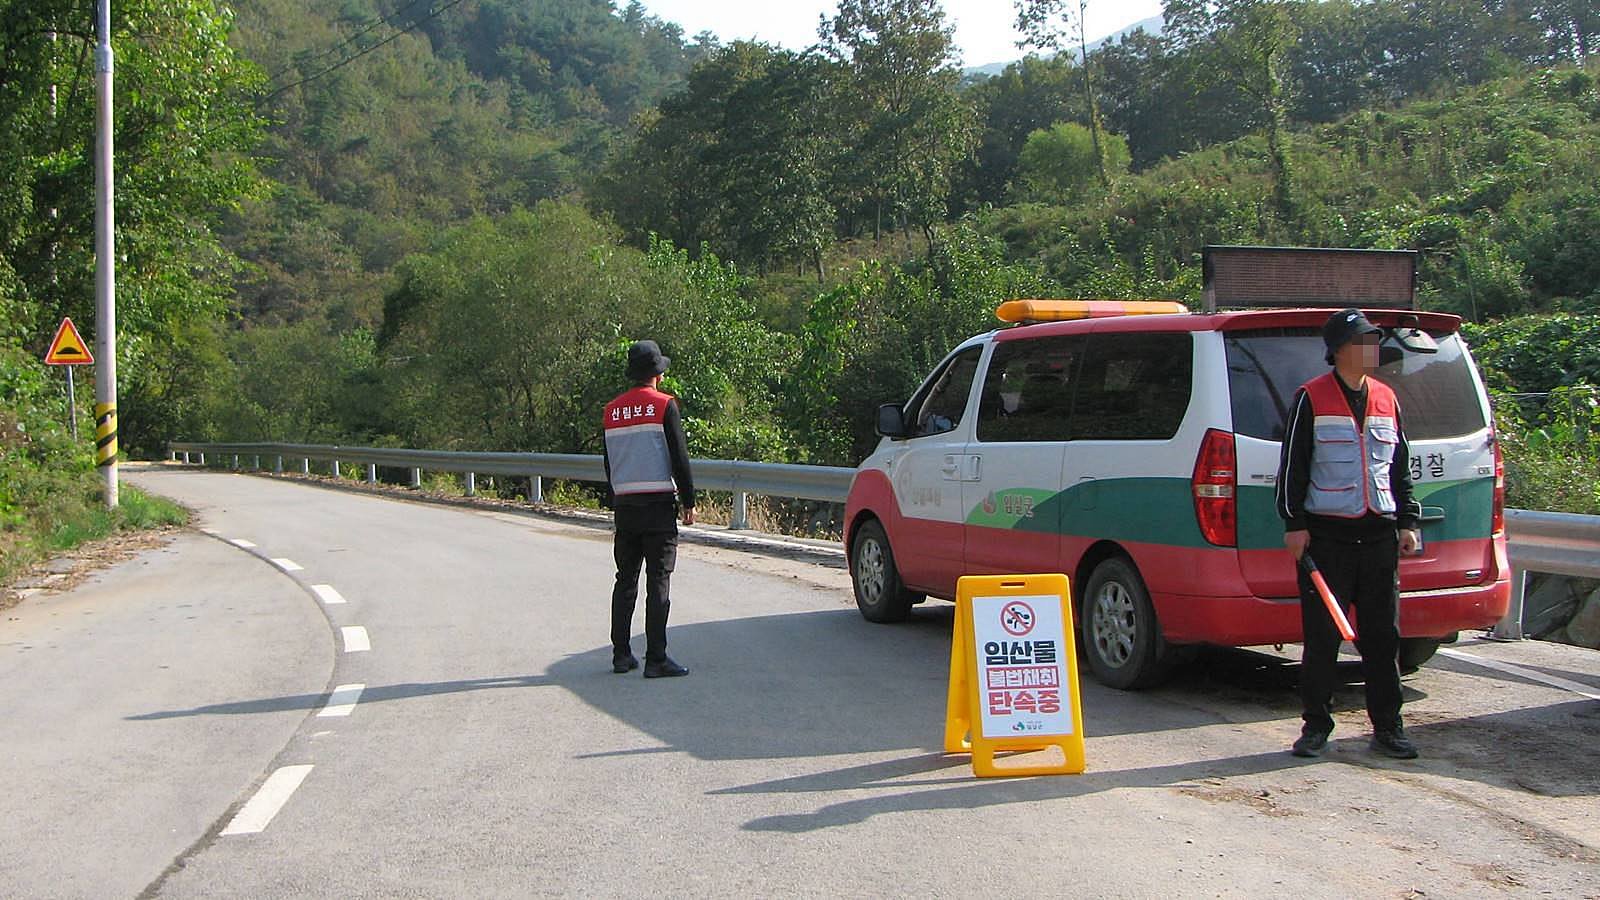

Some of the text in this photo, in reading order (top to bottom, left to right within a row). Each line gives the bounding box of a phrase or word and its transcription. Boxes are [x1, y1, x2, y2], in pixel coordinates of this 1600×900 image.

[611, 403, 656, 421] 산림보호
[1409, 453, 1445, 480] 경찰
[1003, 495, 1035, 518] 임실군
[984, 640, 1056, 665] 임산물
[988, 667, 1057, 688] 불법채취
[988, 690, 1060, 715] 단속중
